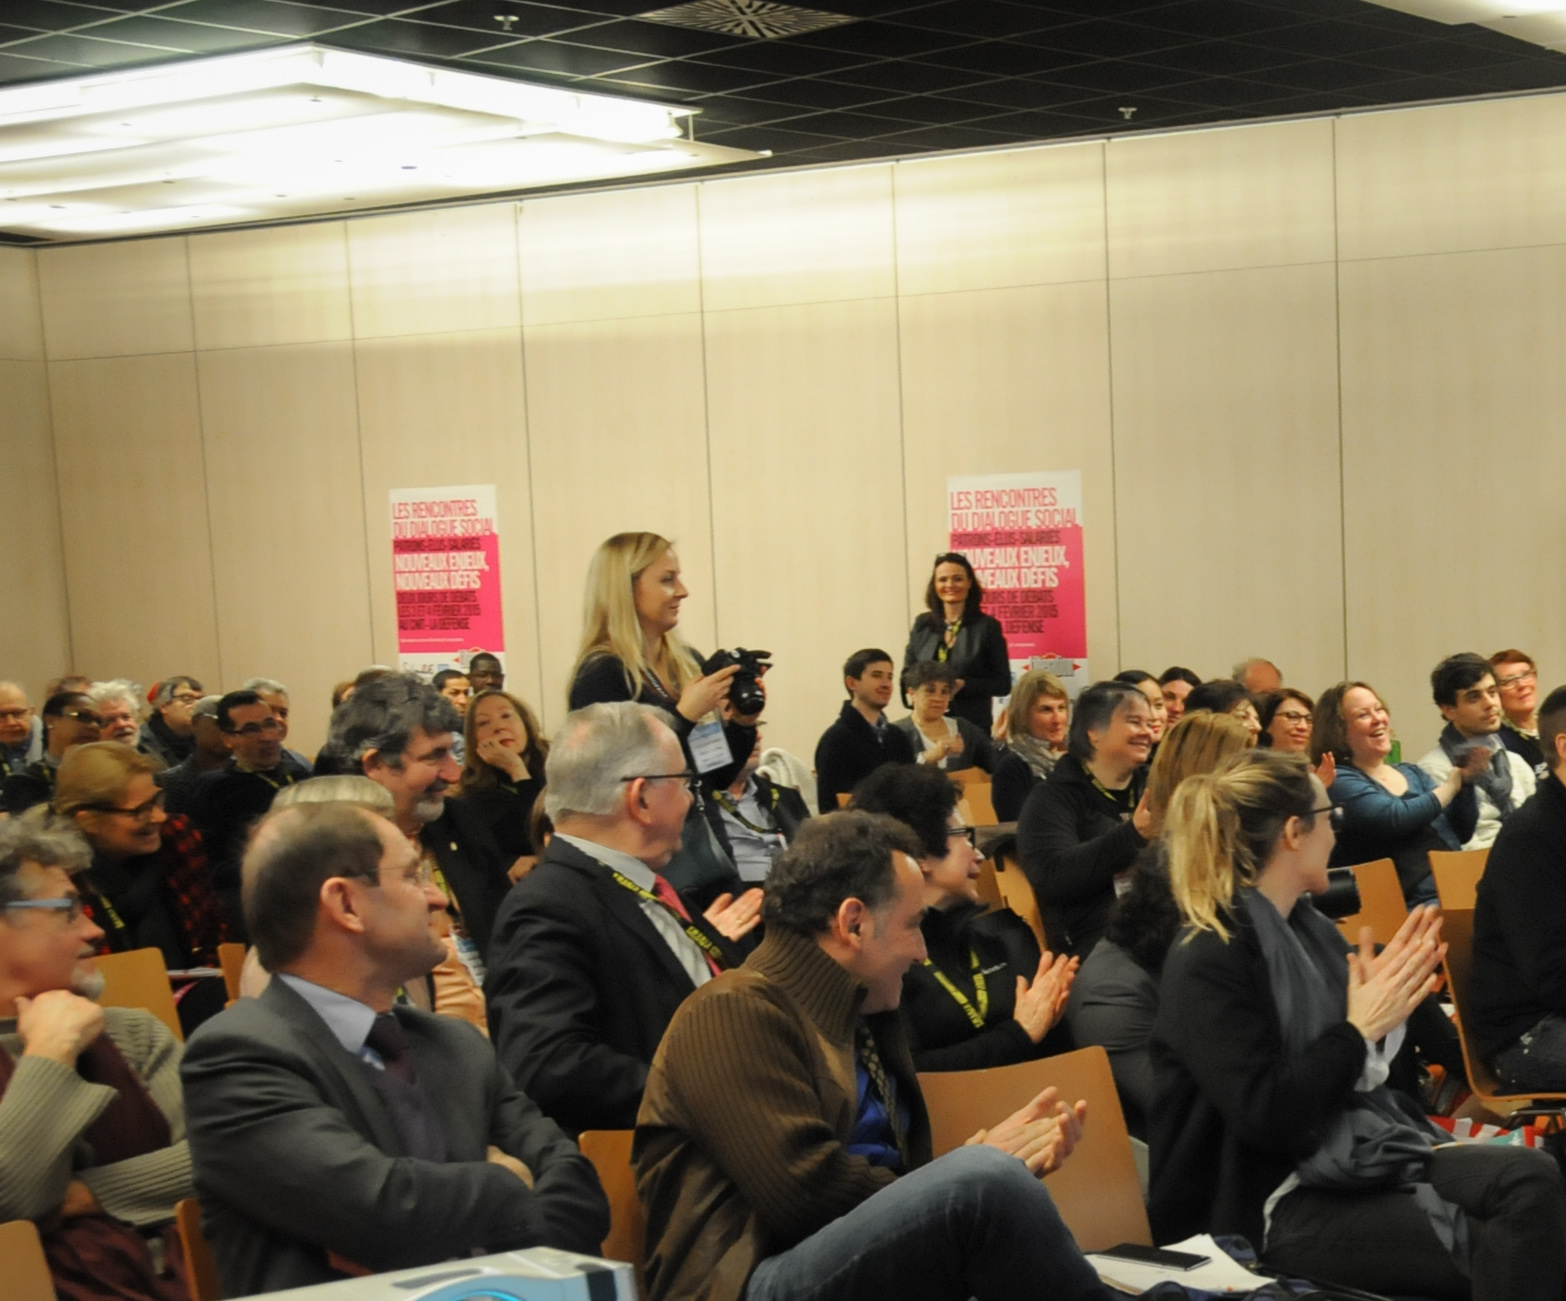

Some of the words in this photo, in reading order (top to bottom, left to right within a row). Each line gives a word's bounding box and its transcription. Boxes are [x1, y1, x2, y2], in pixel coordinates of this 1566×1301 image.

[392, 502, 410, 520] LES
[411, 499, 477, 519] RENCONTRES
[950, 491, 973, 511] LES
[974, 487, 1058, 510] RENCONTRES
[410, 518, 458, 538] DIALOGUE
[459, 517, 493, 537] SOCIAL
[951, 512, 970, 532] DU
[972, 509, 1032, 531] DIALOGUE
[1034, 507, 1077, 529] SOCIAL
[395, 553, 449, 572] NOUVEAUX
[449, 551, 490, 572] ENJEUX,
[1020, 545, 1071, 569] ENJEUX,
[395, 571, 451, 592] NOUVEAUX
[451, 568, 482, 590] DÉFIS
[1020, 566, 1060, 589] DÉFIS
